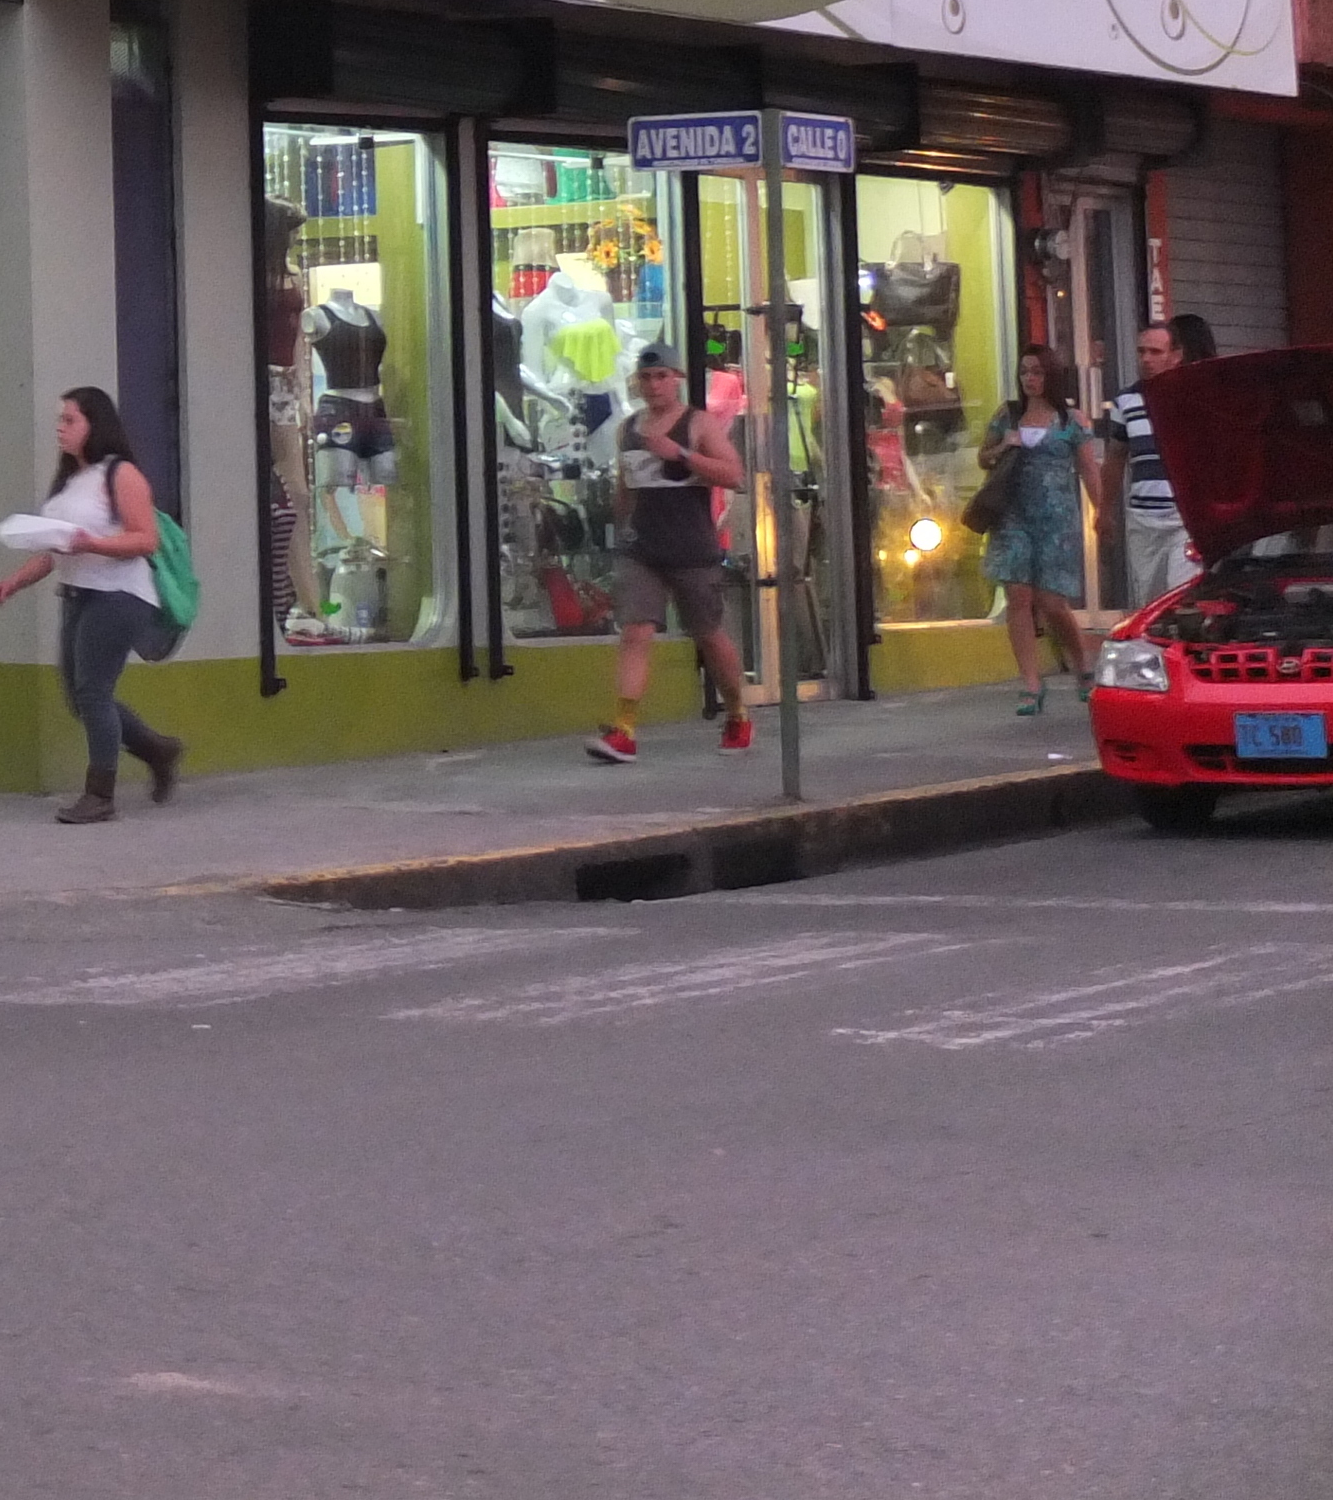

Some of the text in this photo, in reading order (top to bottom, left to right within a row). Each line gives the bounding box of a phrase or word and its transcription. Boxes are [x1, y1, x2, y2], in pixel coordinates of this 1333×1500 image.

[635, 124, 757, 160] AVENIDA 2
[786, 123, 834, 158] CALLE
